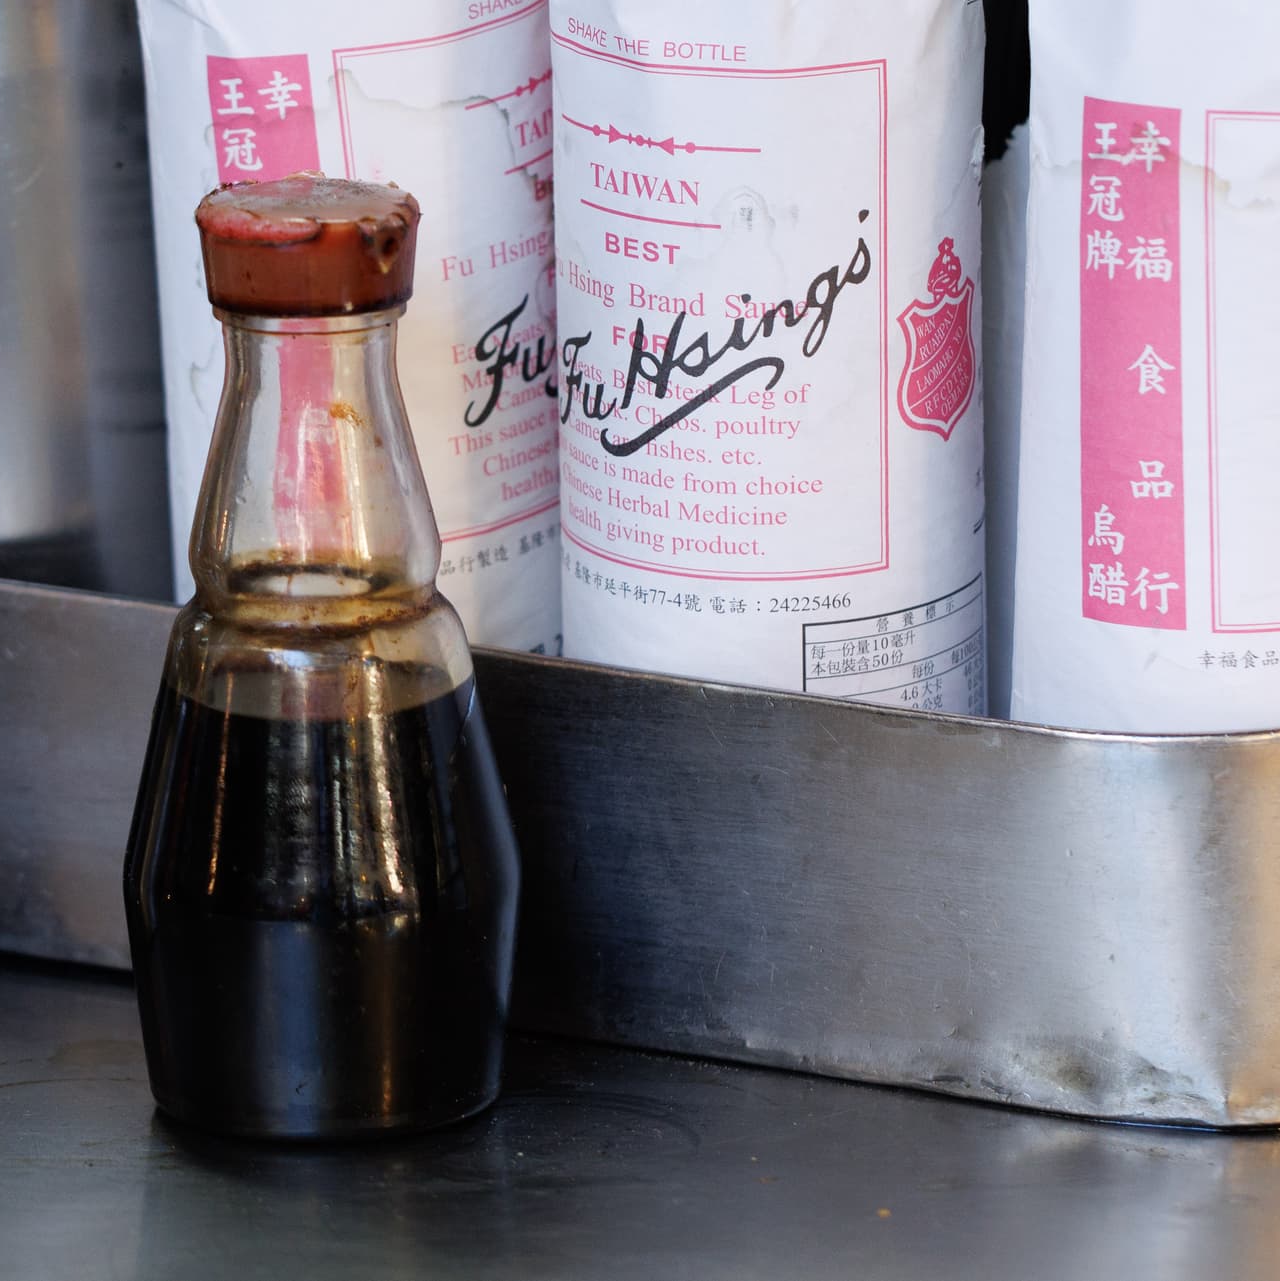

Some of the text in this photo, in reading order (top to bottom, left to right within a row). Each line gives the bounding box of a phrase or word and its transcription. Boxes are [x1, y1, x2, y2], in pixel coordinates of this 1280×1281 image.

[567, 17, 747, 62] SHAKE THE BOTTLE
[258, 70, 302, 120] 幸
[216, 77, 264, 171] 王冠
[515, 107, 553, 148] TAI
[590, 162, 700, 206] TAIWAN
[1086, 120, 1124, 280] 王冠牌
[440, 231, 550, 282] Fu Hsing
[604, 231, 681, 265] BEST
[568, 260, 615, 308] Hsing
[628, 282, 705, 317] Brand
[724, 293, 809, 320] Sauce
[560, 330, 618, 425] Fu
[612, 368, 653, 396] Bst
[729, 384, 776, 409] Leg
[783, 382, 812, 405] of
[1126, 120, 1181, 615] 幸福食品行
[448, 429, 493, 456] This
[715, 415, 801, 440] poultry
[483, 439, 552, 476] Chinese
[569, 442, 599, 471] sauce
[604, 456, 617, 477] is
[622, 466, 675, 490] made
[683, 473, 737, 495] from
[745, 475, 824, 497] choice
[720, 446, 763, 466] etc.
[501, 468, 555, 501] health
[608, 487, 670, 519] Herbal
[678, 502, 788, 526] Medicine
[568, 494, 766, 557] health giving product.
